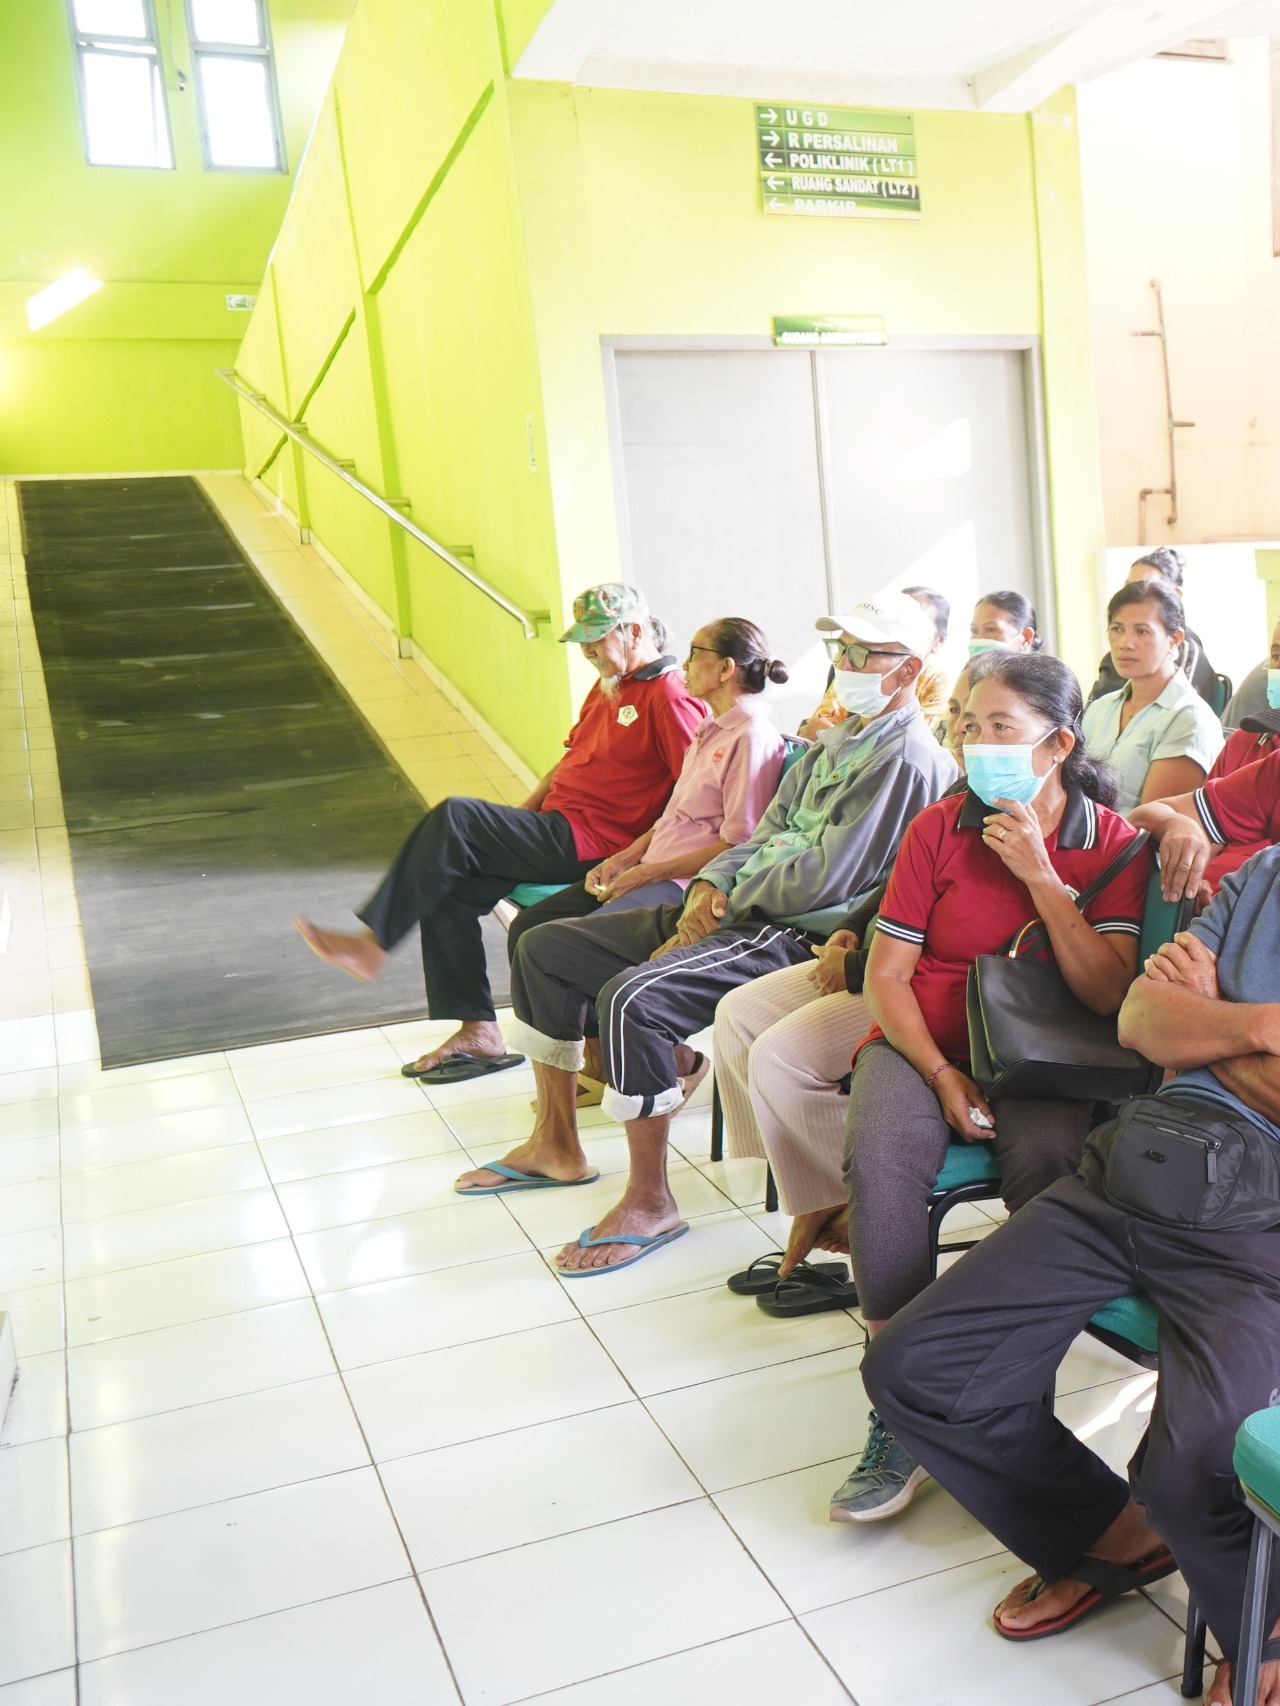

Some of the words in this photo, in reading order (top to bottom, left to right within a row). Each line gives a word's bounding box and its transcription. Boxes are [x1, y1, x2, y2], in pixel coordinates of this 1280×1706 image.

[788, 132, 800, 148] R
[803, 133, 897, 152] PERSALINAN
[790, 153, 869, 171] POLIKLINIK
[792, 176, 832, 191] RUANG
[835, 178, 879, 193] SANDAT
[794, 199, 857, 214] PARKIR
